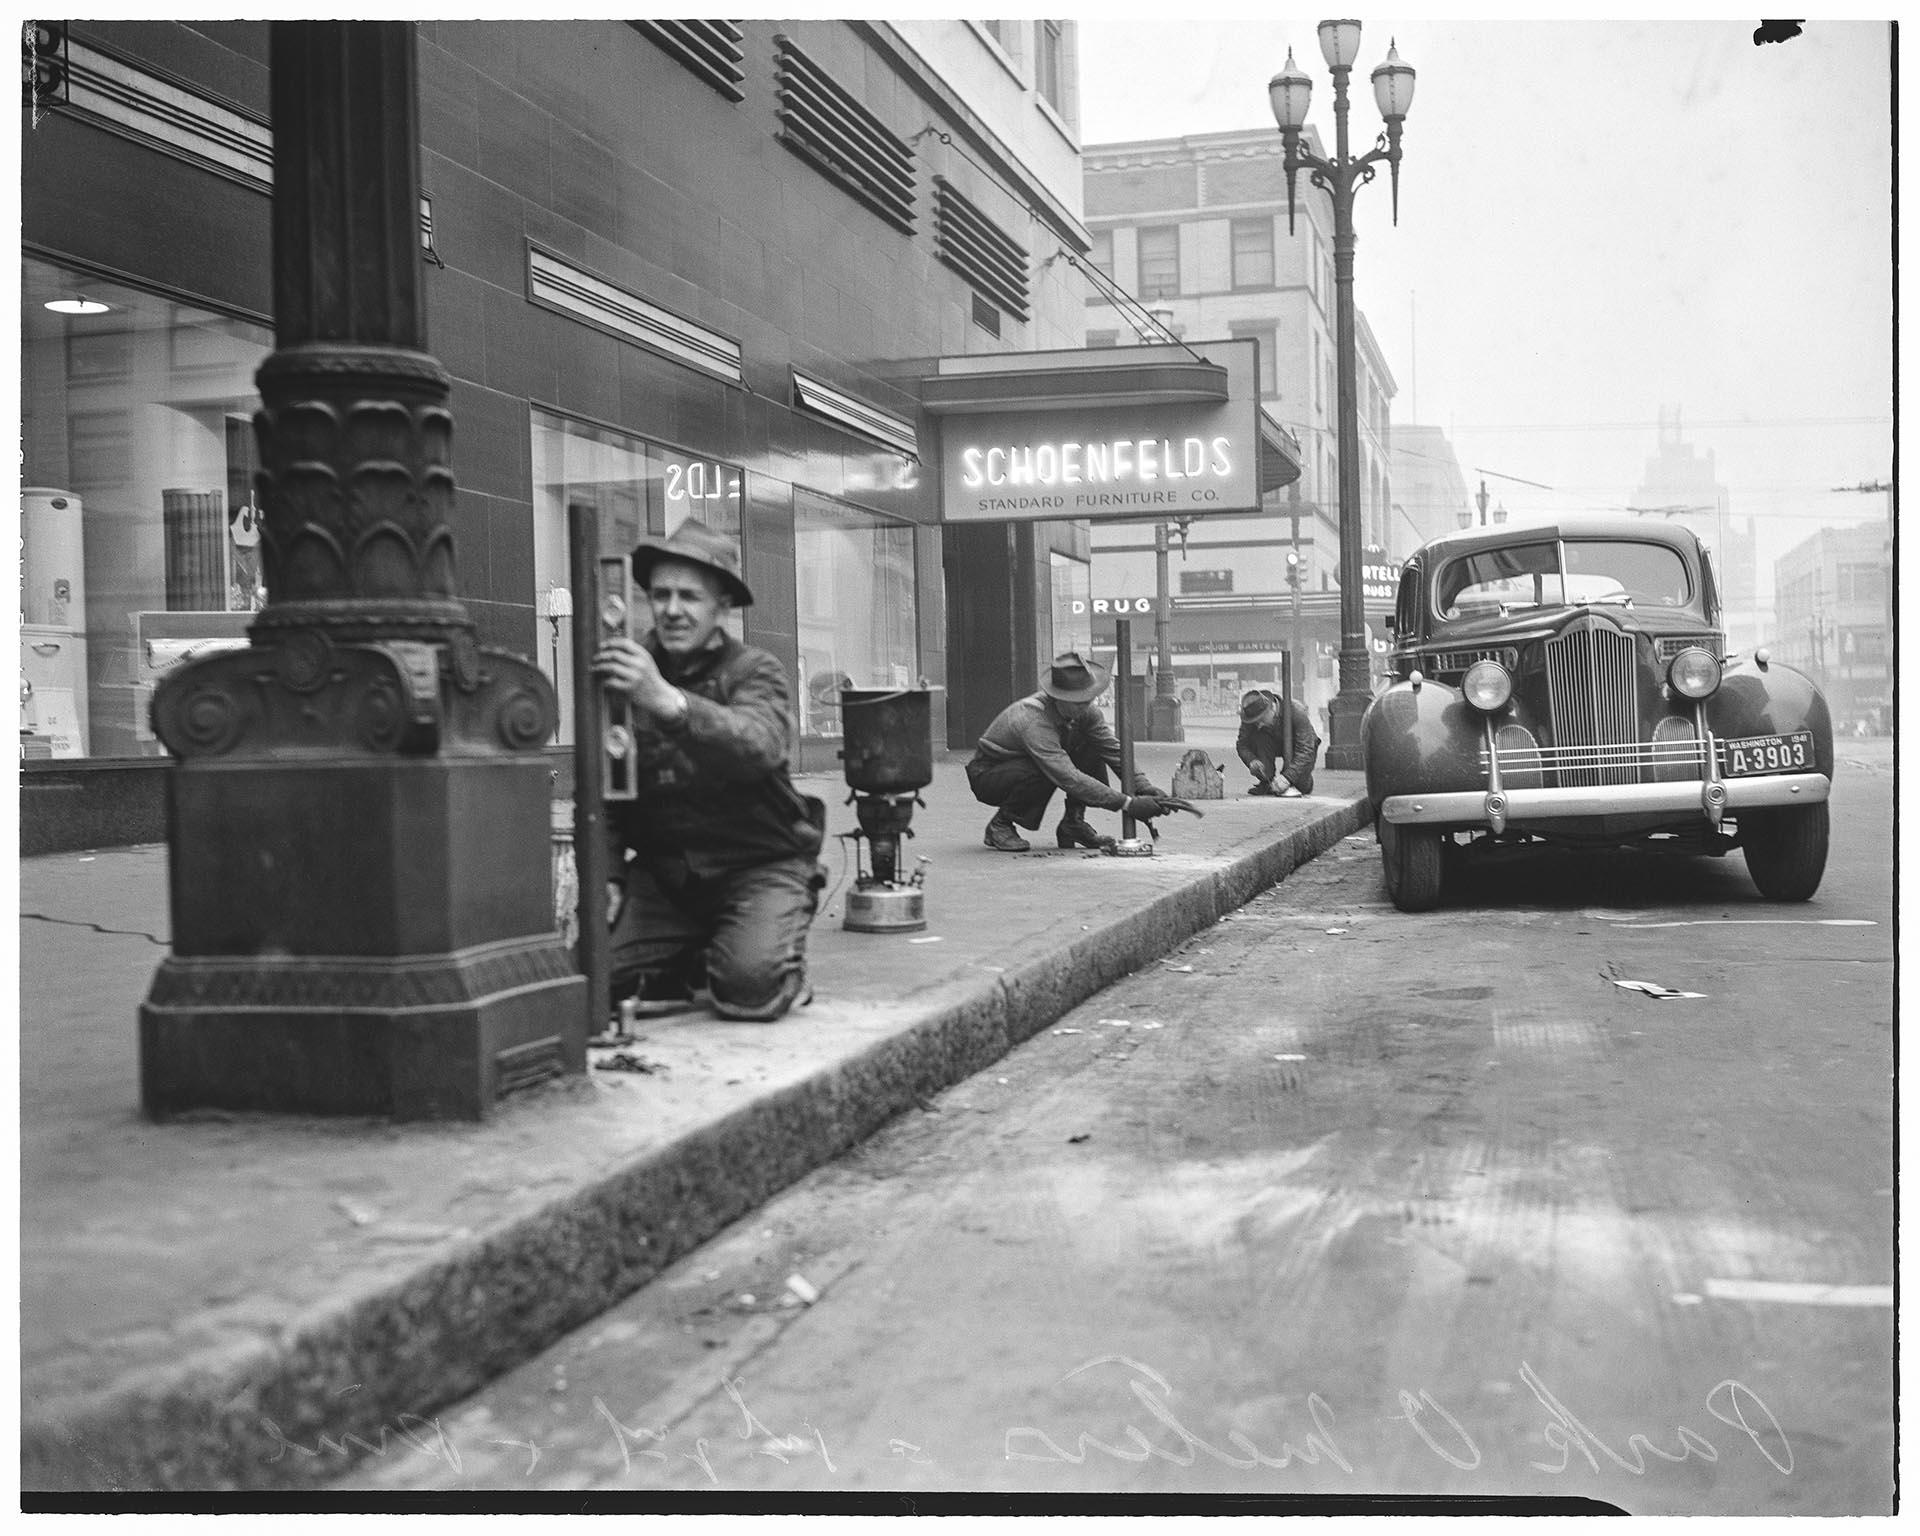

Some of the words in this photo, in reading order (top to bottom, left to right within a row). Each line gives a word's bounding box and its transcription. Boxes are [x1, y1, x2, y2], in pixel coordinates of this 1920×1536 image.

[962, 437, 1232, 486] SCHOENFELDS
[978, 495, 1064, 511] STANDARD
[1076, 491, 1177, 507] FURNITURE
[1192, 489, 1219, 502] CO.
[1363, 584, 1392, 597] RUGS
[1729, 738, 1783, 750] WASHINGTON
[1791, 735, 1808, 743] 1941
[1733, 743, 1805, 772] A-3903
